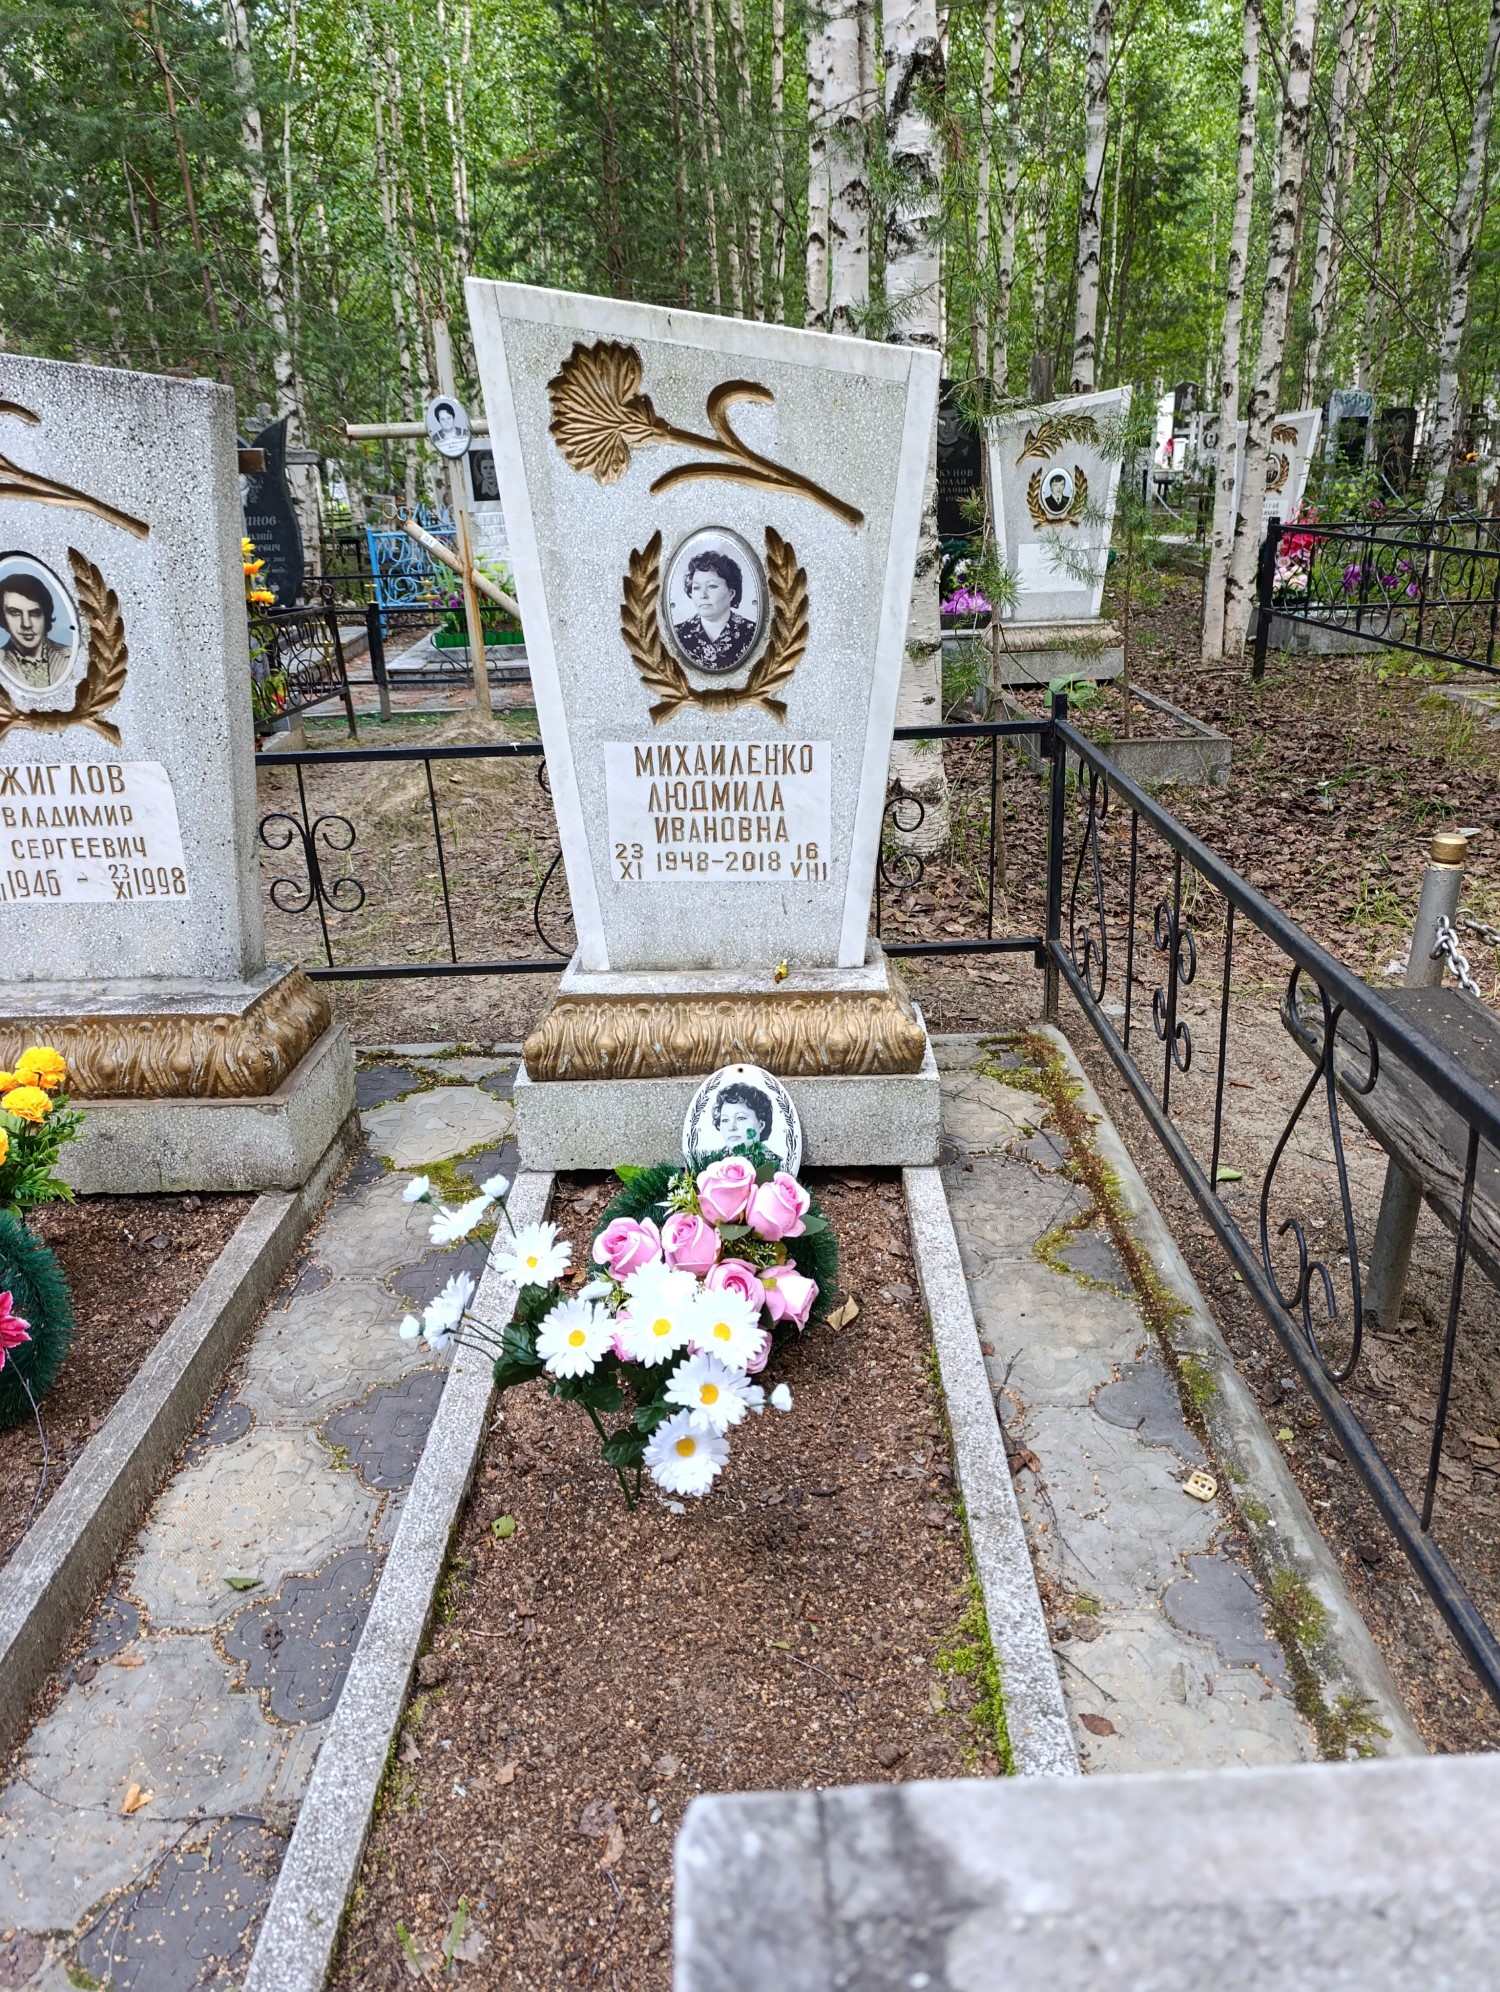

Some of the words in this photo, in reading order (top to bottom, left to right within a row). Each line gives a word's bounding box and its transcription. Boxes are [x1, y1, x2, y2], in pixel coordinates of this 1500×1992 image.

[0, 765, 126, 796] ЖИГЛОВ
[648, 780, 786, 813] ЛЮДМИЛА
[2, 805, 133, 829] ВЛАДИМИР
[654, 816, 790, 844] ИВАНОВНА
[11, 836, 147, 860] СЕРГЕЕВИЧ
[615, 843, 644, 860] 23
[796, 842, 819, 860] 16
[108, 864, 130, 880] 23
[133, 867, 187, 895] 1998
